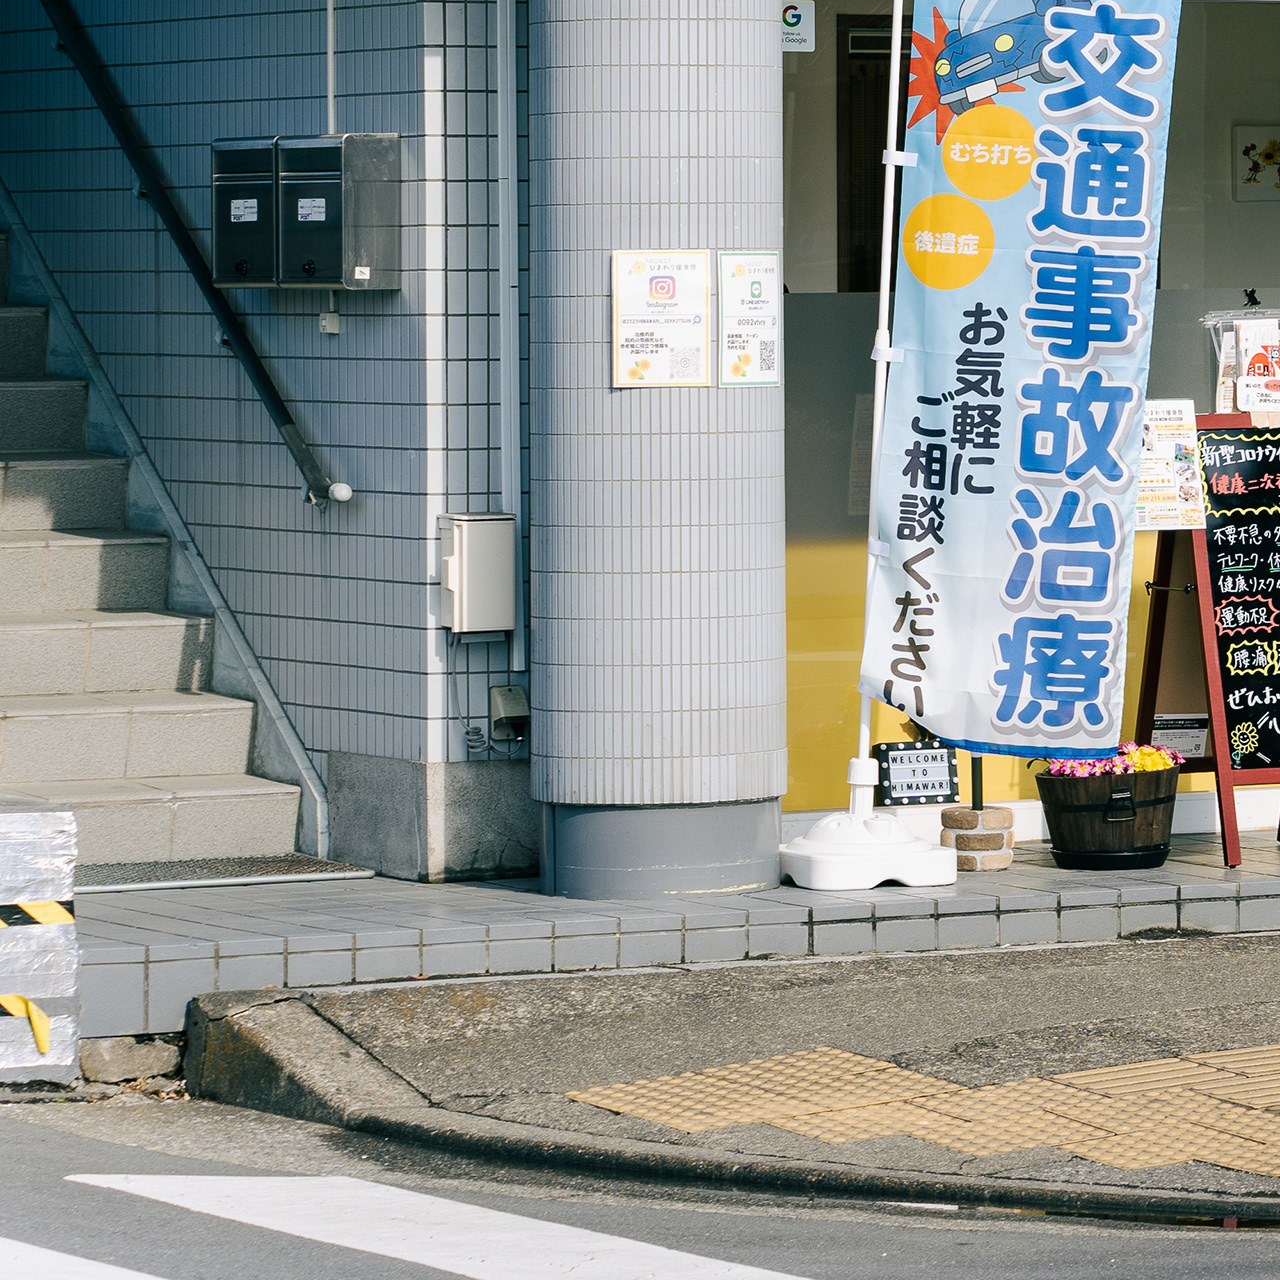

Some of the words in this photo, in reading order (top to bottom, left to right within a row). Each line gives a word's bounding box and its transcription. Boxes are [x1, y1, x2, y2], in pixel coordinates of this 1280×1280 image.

[949, 141, 1033, 167] むち打ち
[913, 230, 980, 256] 後遺症
[645, 301, 679, 310] Instagram
[995, 1, 1165, 729] 交通事故治療
[950, 301, 1009, 497] お気軽に
[882, 390, 956, 719] ご相談ください
[1220, 606, 1270, 629] 運動不足
[1233, 649, 1268, 669] 腰痛
[890, 754, 945, 764] WELCOME
[912, 768, 928, 777] TO
